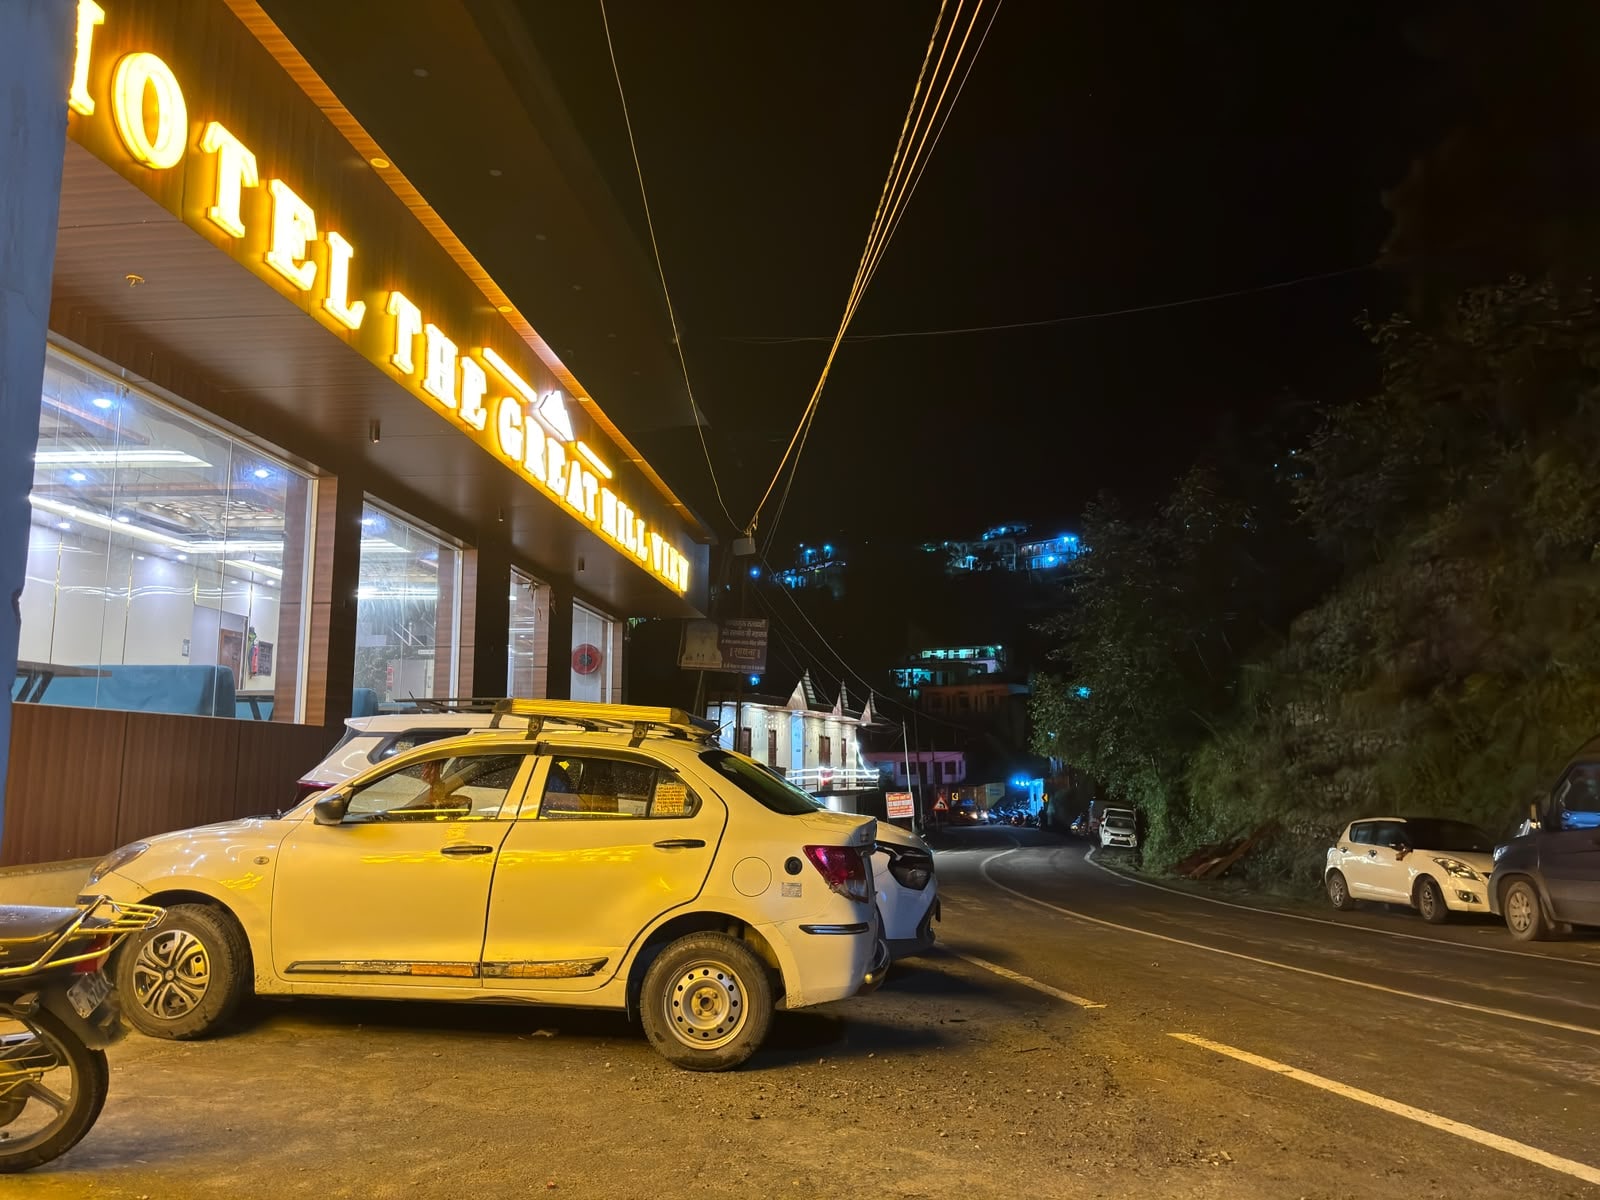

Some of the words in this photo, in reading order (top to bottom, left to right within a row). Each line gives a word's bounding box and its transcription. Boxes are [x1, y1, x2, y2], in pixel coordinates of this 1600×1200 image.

[386, 290, 487, 431] THE
[497, 396, 599, 522] GREAT
[600, 487, 648, 562] HILL
